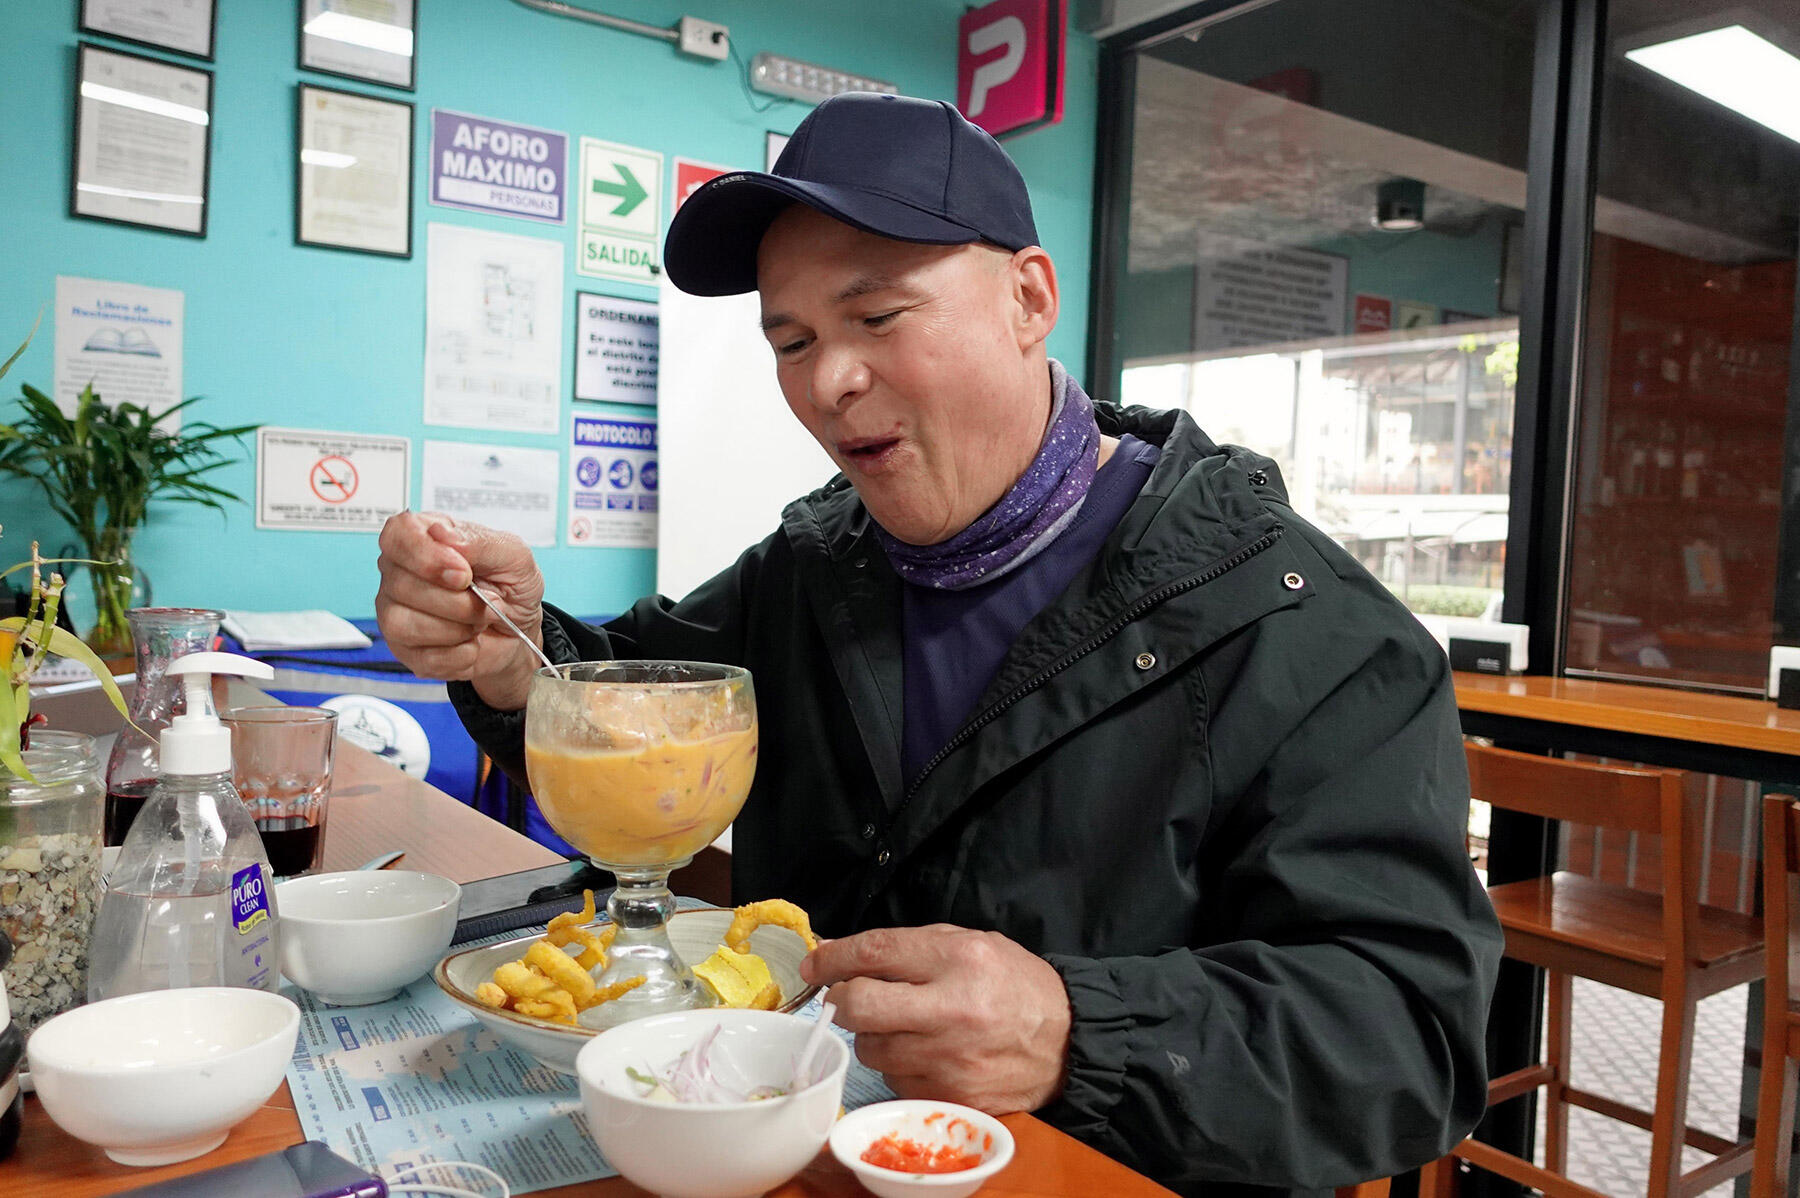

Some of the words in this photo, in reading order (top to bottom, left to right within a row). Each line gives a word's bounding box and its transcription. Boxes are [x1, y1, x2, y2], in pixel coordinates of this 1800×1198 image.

[967, 15, 1027, 119] P
[453, 122, 549, 163] AFORO
[442, 150, 557, 193] MAXIMO
[490, 189, 555, 211] PERSONAS
[587, 242, 652, 267] SALIDA
[576, 421, 652, 446] PROTOCOLO
[233, 878, 263, 906] PURO
[239, 897, 260, 916] CLEAN
